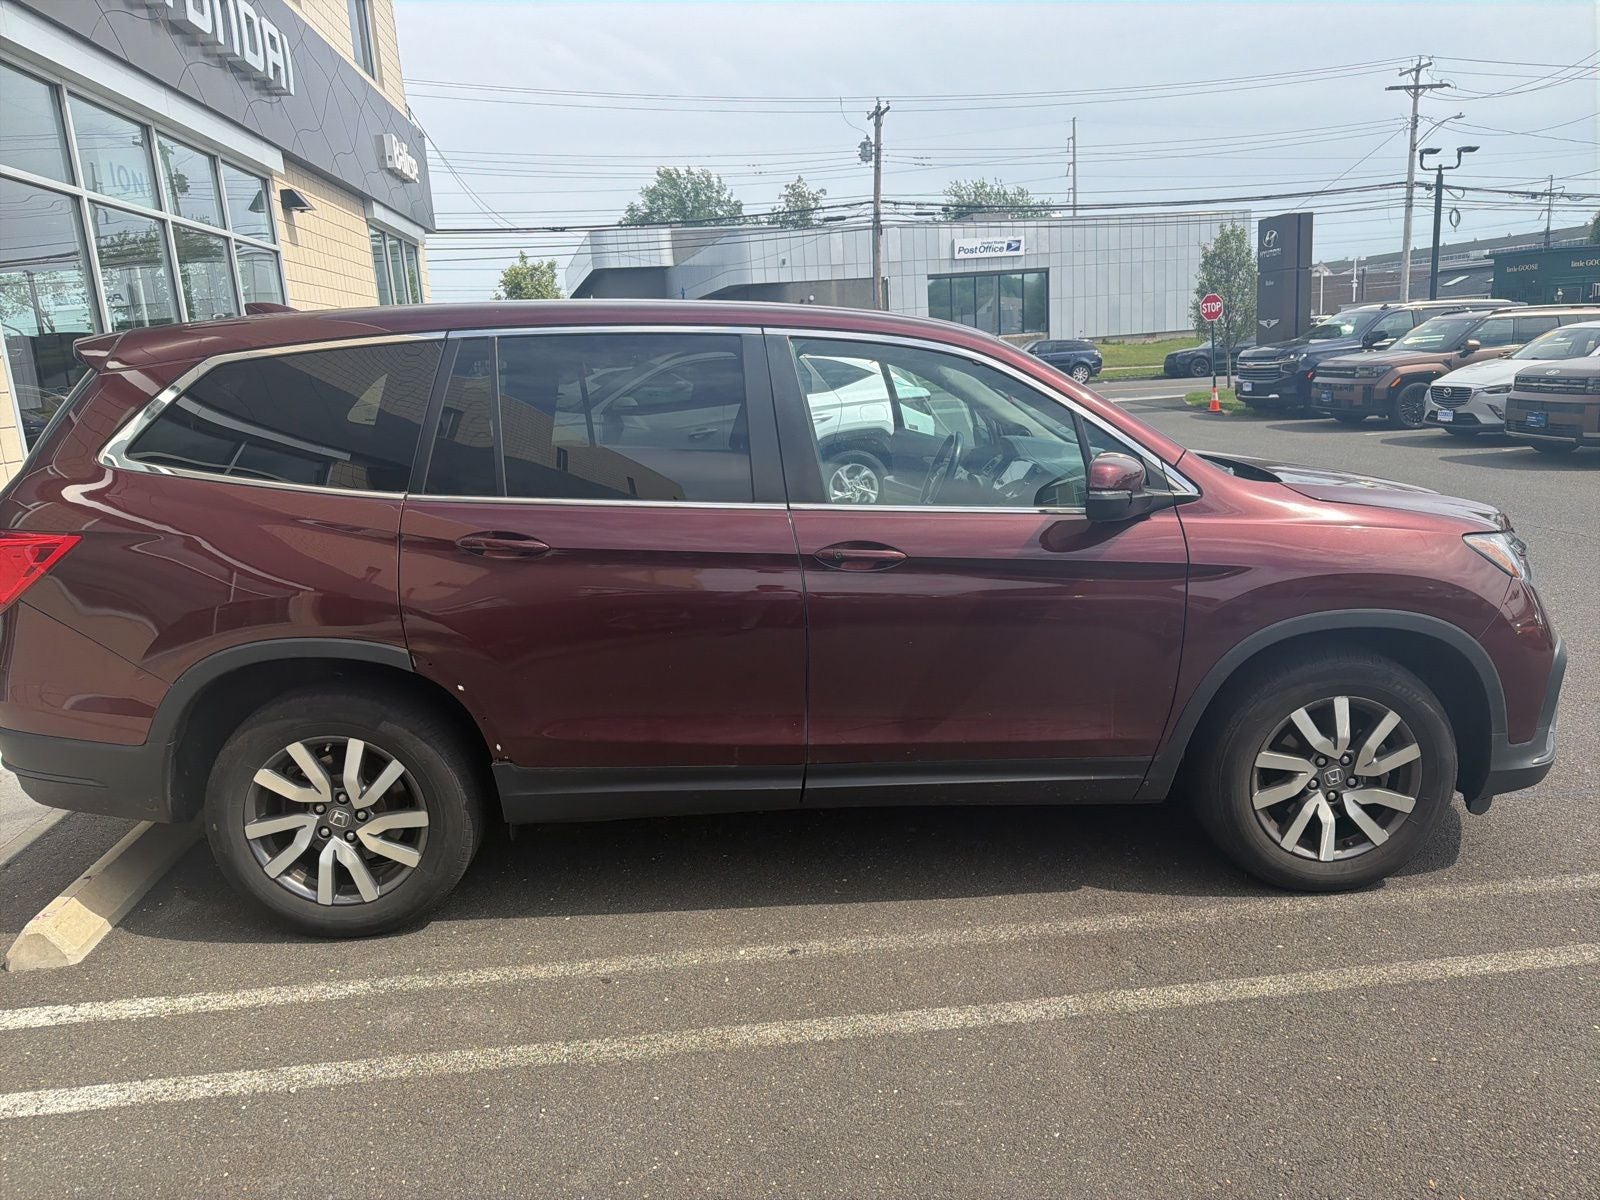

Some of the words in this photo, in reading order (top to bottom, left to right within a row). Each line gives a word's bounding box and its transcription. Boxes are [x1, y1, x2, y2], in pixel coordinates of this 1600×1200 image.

[163, 0, 294, 96] UNDAI
[957, 246, 977, 254] Post
[979, 245, 1004, 253] Office
[1586, 258, 1600, 266] GOO
[1518, 263, 1538, 271] GOOSE
[1202, 301, 1221, 313] STOP
